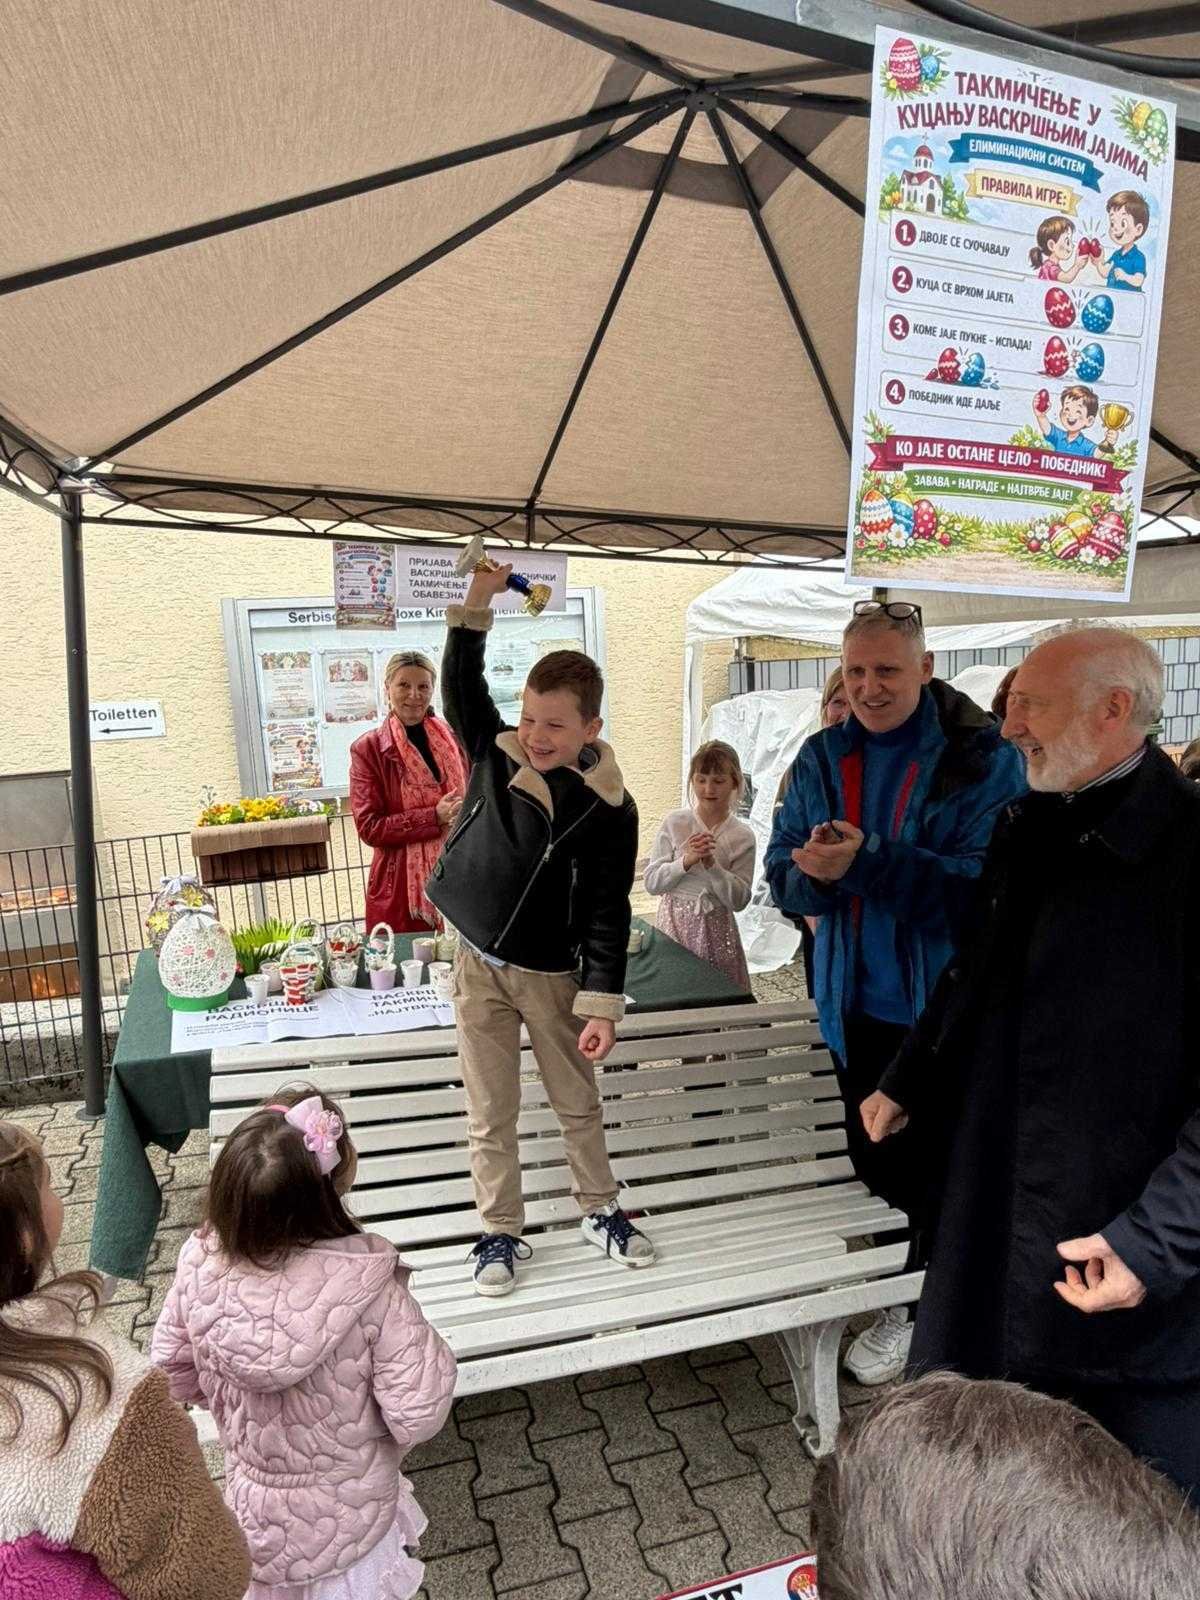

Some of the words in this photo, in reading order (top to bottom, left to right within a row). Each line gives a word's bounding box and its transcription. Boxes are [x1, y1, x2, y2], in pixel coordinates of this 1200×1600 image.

[954, 71, 1081, 120] ТАКМИЧЕЊЕ
[1088, 103, 1101, 127] У
[897, 100, 976, 130] КУЦАЊУ
[978, 105, 1086, 151] ВАСКРШЊИМ
[1087, 134, 1149, 182] ЈАЈИМА
[969, 139, 1046, 164] ЕЛИМИНАЦИОНИ
[1047, 153, 1086, 175] СИСТЕМ
[981, 176, 1033, 200] ПРАВИЛА
[1036, 186, 1067, 206] ИГРЕ:
[900, 224, 912, 242] 1.
[919, 230, 948, 246] ДВОЈЕ
[950, 236, 961, 248] СЕ
[963, 238, 1011, 257] СУОЧАВАЈУ
[897, 271, 910, 289] 2.
[916, 277, 940, 292] КУЦА
[942, 282, 953, 294] СЕ
[954, 284, 984, 299] ВРХОМ
[985, 289, 1014, 304] ЈАЈЕТА
[893, 318, 906, 338] 3.
[913, 323, 937, 337] КОМЕ
[939, 328, 957, 341] ЈАЈЕ
[959, 331, 987, 344] ПУКНЕ
[995, 336, 1032, 351] ИСПАДА!
[889, 383, 903, 401] 4.
[909, 389, 954, 406] ПОБЕДНИК
[955, 396, 974, 408] ИДЕ
[975, 398, 1001, 411] ДАЉЕ
[895, 440, 913, 456] КО
[915, 443, 944, 459] ЈАЈЕ
[947, 444, 994, 463] ОСТАНЕ
[998, 448, 1031, 468] ЦЕЛО
[1040, 455, 1106, 478] ПОБЕДНИК!
[958, 477, 999, 493] НАГРАДЕ
[1052, 489, 1073, 501] ЈАЈЕ!
[409, 557, 453, 568] ПРИЈАВА
[409, 578, 468, 590] ТАКМИЧЕЊЕ
[412, 590, 464, 600] ОБАВЕЗНА
[89, 708, 157, 721] Toiletten
[205, 1005, 319, 1021] РАДИОНИЦЕ
